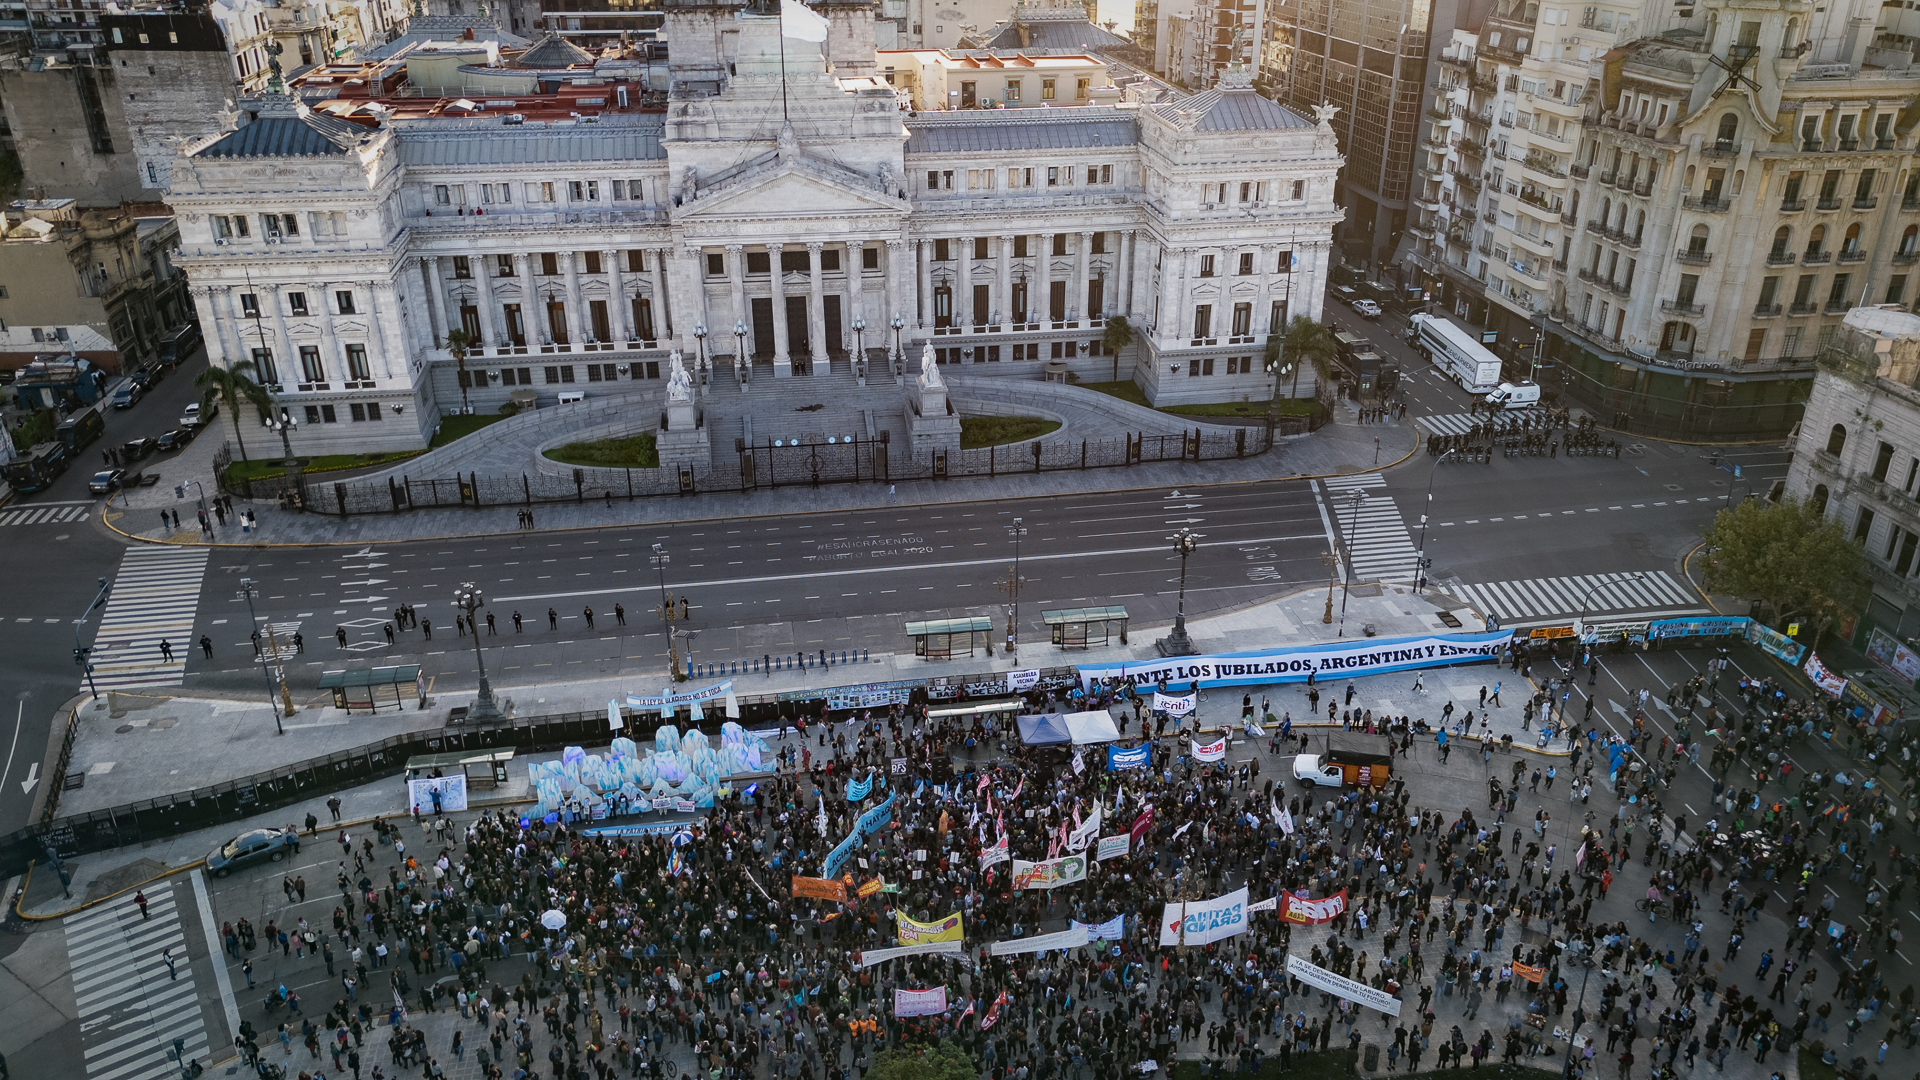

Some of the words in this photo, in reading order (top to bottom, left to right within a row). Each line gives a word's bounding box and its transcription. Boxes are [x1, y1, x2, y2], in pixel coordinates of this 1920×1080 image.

[1674, 358, 1720, 371] MOLINO
[1177, 665, 1211, 679] LOS
[1215, 658, 1318, 678] JUBILADOS,
[1320, 646, 1423, 670] ARGENTINA
[1424, 645, 1436, 657] Y
[693, 692, 700, 700] NO
[701, 690, 708, 698] SE
[708, 686, 722, 697] TOCA
[866, 684, 878, 692] NO
[865, 815, 881, 828] HAY
[1309, 971, 1332, 984] QUIEREN
